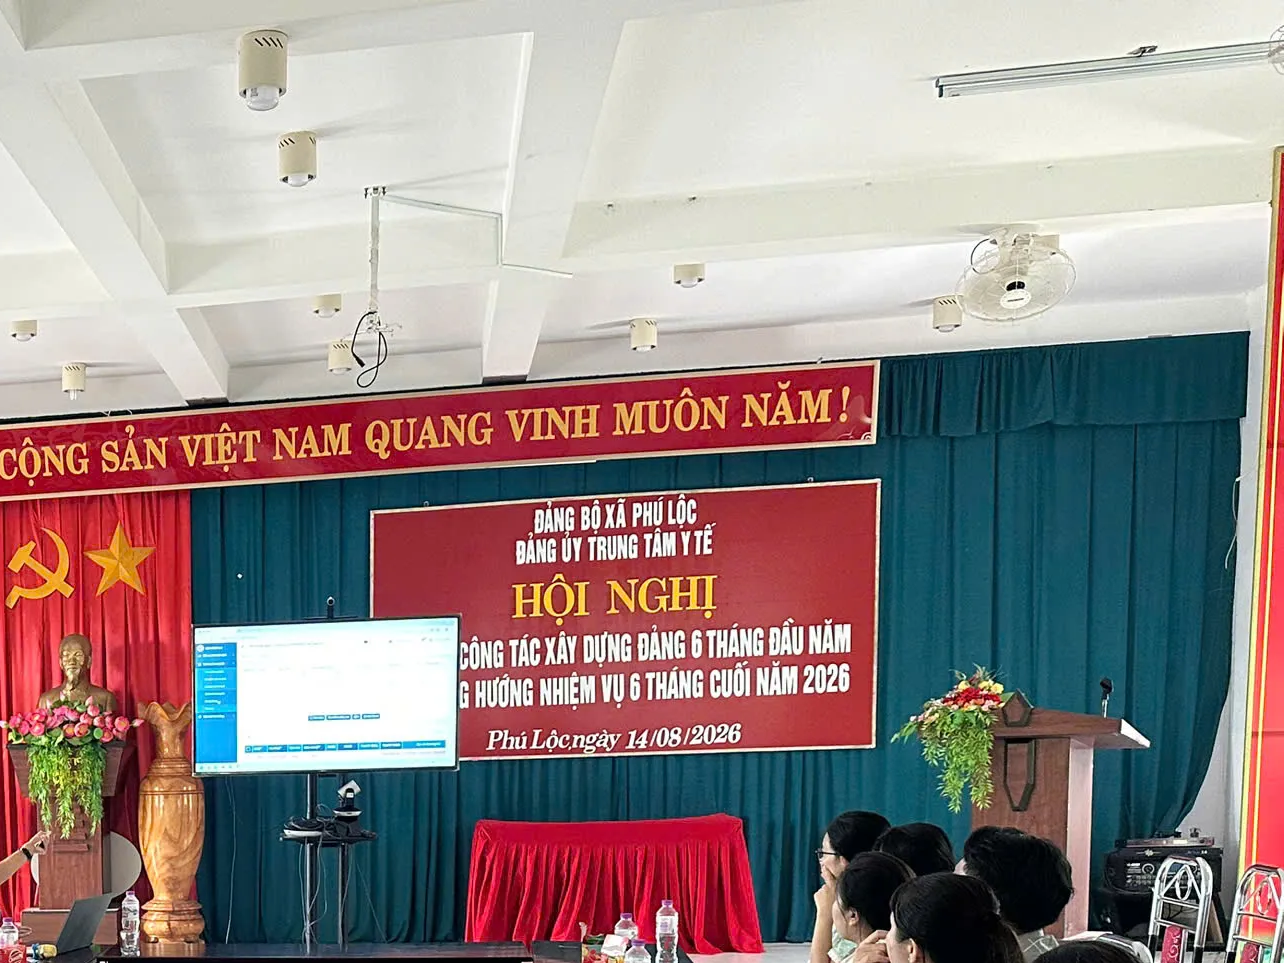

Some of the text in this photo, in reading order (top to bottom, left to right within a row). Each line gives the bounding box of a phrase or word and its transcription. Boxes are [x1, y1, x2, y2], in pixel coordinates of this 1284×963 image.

[101, 425, 168, 472] SẢN
[184, 423, 260, 472] VIỆT
[273, 423, 351, 460] NAM
[366, 412, 493, 459] QUANG
[505, 405, 600, 442] VINH
[613, 388, 729, 435] MUÔN
[534, 494, 696, 534] ĐẢNG BỘ XÃ PHÚ LỘC
[516, 523, 716, 565] ĐẢNG ỦY TRUNG TÂM Y TẾ
[512, 574, 717, 625] HỘI NGHỊ
[460, 618, 851, 670] CÔNG TÁC XÂY DỰNG ĐẢNG 6 THÁNG ĐẦU NĂM
[476, 674, 533, 708] HƯỚNG
[540, 672, 595, 710] NHIỆM
[601, 674, 624, 708] VỤ
[630, 673, 640, 701] 6
[645, 666, 703, 700] THÁNG
[710, 661, 750, 698] CUỐI
[757, 661, 798, 696] NĂM
[803, 663, 849, 693] 2026
[486, 730, 527, 750] Phú
